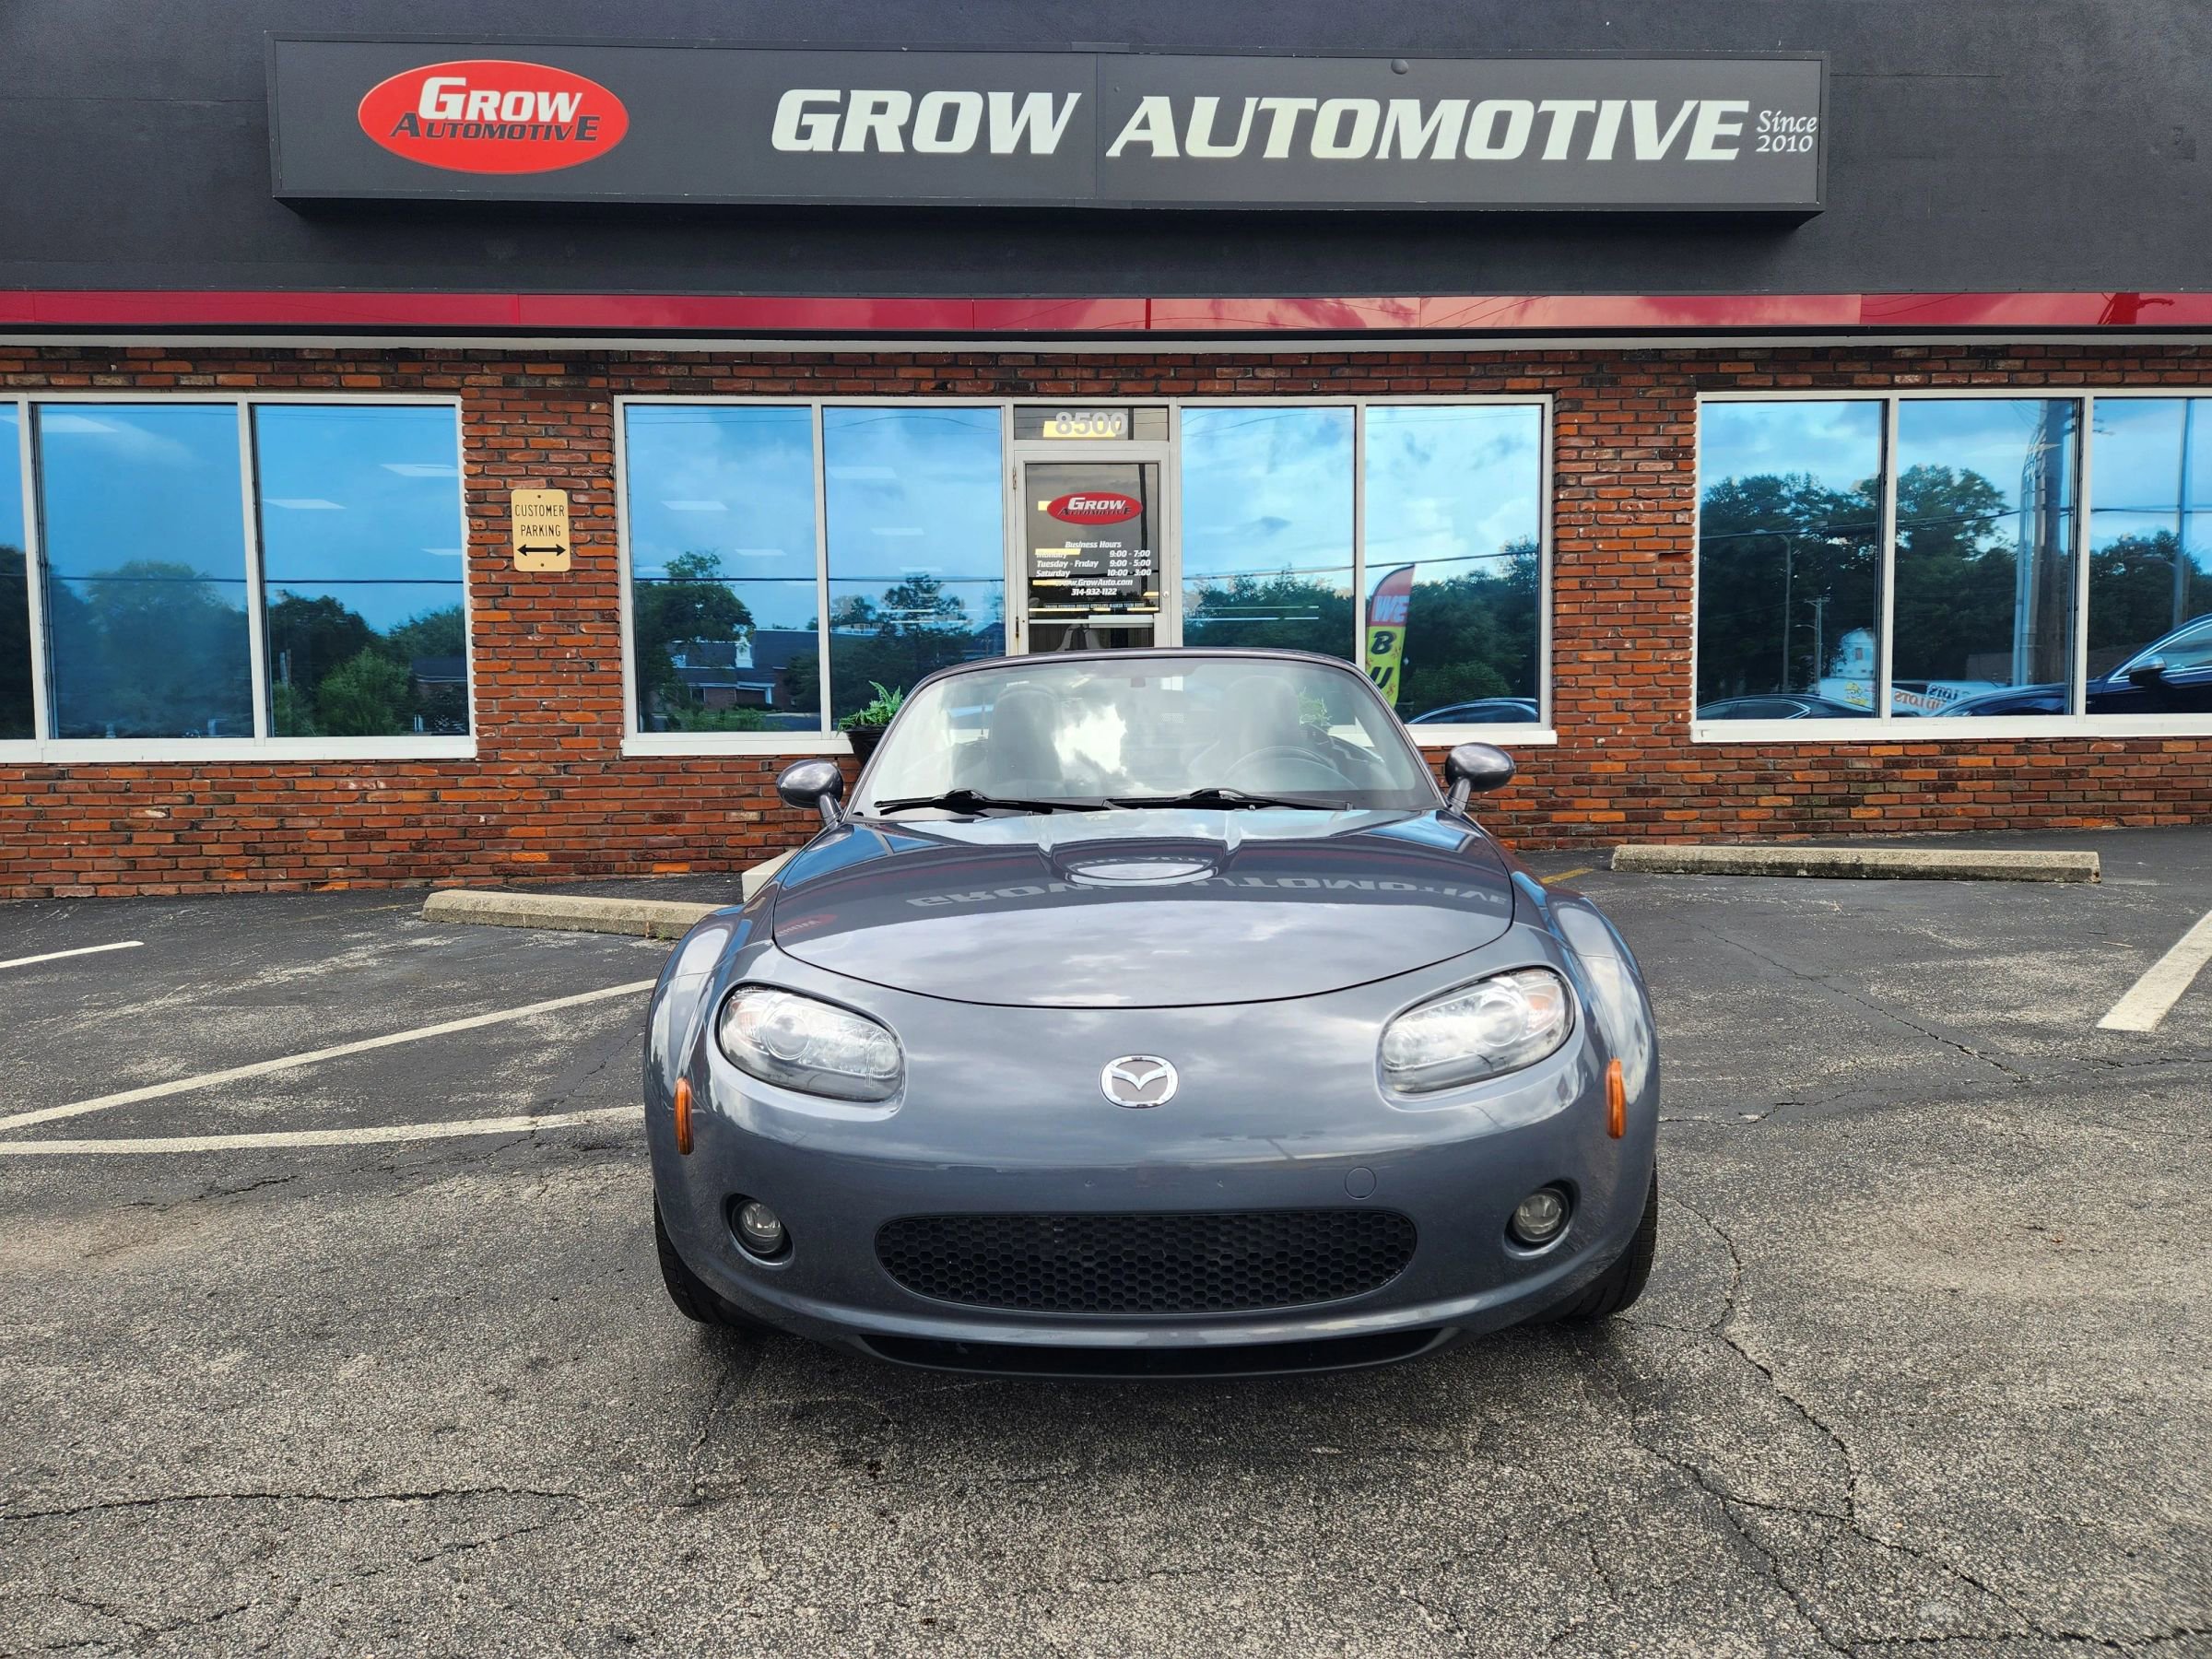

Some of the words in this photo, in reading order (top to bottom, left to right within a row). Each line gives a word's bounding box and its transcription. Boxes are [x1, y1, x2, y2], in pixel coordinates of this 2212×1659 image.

[418, 76, 582, 122] GROW
[389, 112, 601, 141] AUTOMOTIVE
[771, 89, 1082, 154] GROW
[1106, 96, 1749, 160] AUTOMOTIVE
[1756, 109, 1818, 134] Since
[1756, 134, 1814, 153] 2010
[1055, 412, 1127, 435] 8500
[1067, 497, 1126, 510] GROW
[515, 505, 565, 516] CUSTOMER
[521, 524, 561, 536] PARKING
[1099, 540, 1122, 548] Hours
[1134, 549, 1151, 558] 7:00
[1037, 560, 1068, 569] Tuesday
[1036, 570, 1071, 579] Saturday
[1071, 588, 1117, 596] 314-932-1122
